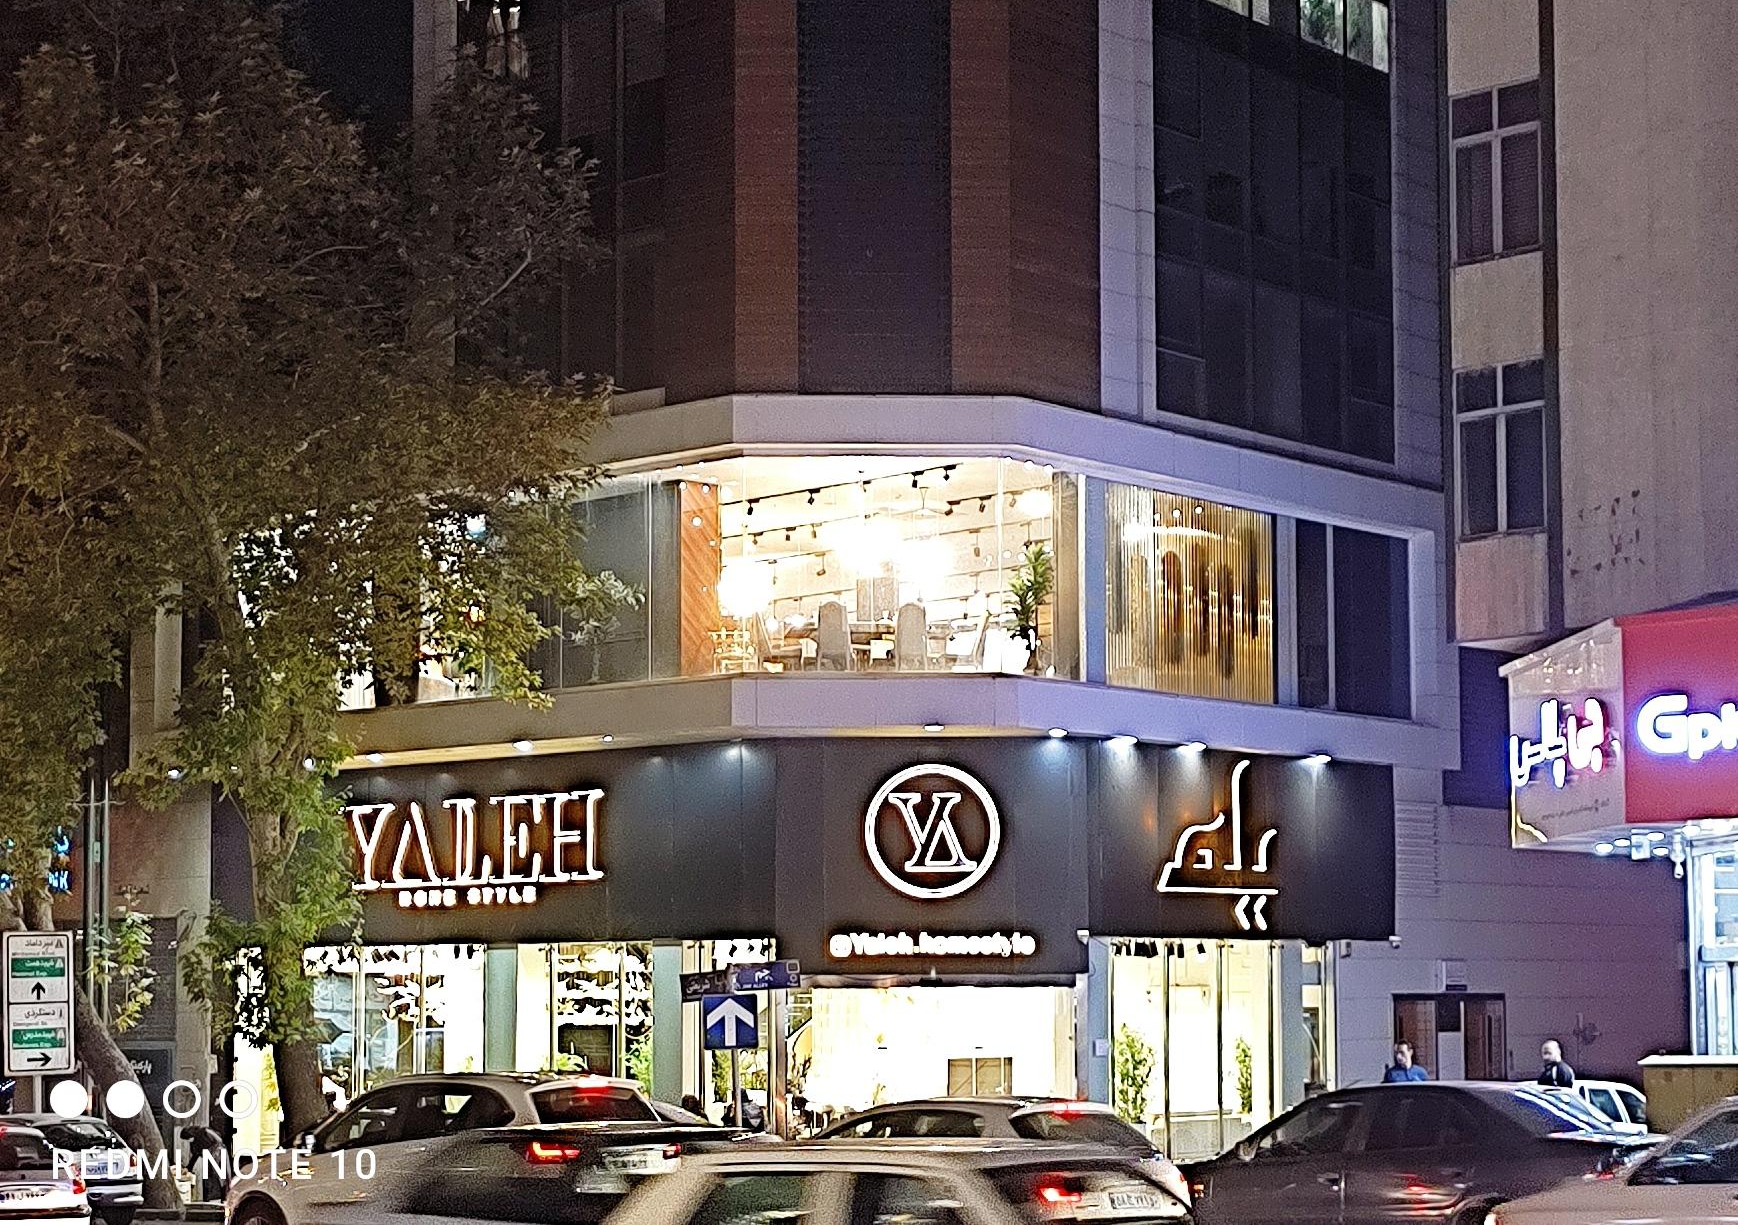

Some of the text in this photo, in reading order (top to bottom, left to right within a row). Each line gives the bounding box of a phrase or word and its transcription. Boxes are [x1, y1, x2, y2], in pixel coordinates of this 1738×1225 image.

[1636, 693, 1738, 760] Gpl
[338, 788, 605, 891] YALEH
[467, 885, 537, 905] STYLE
